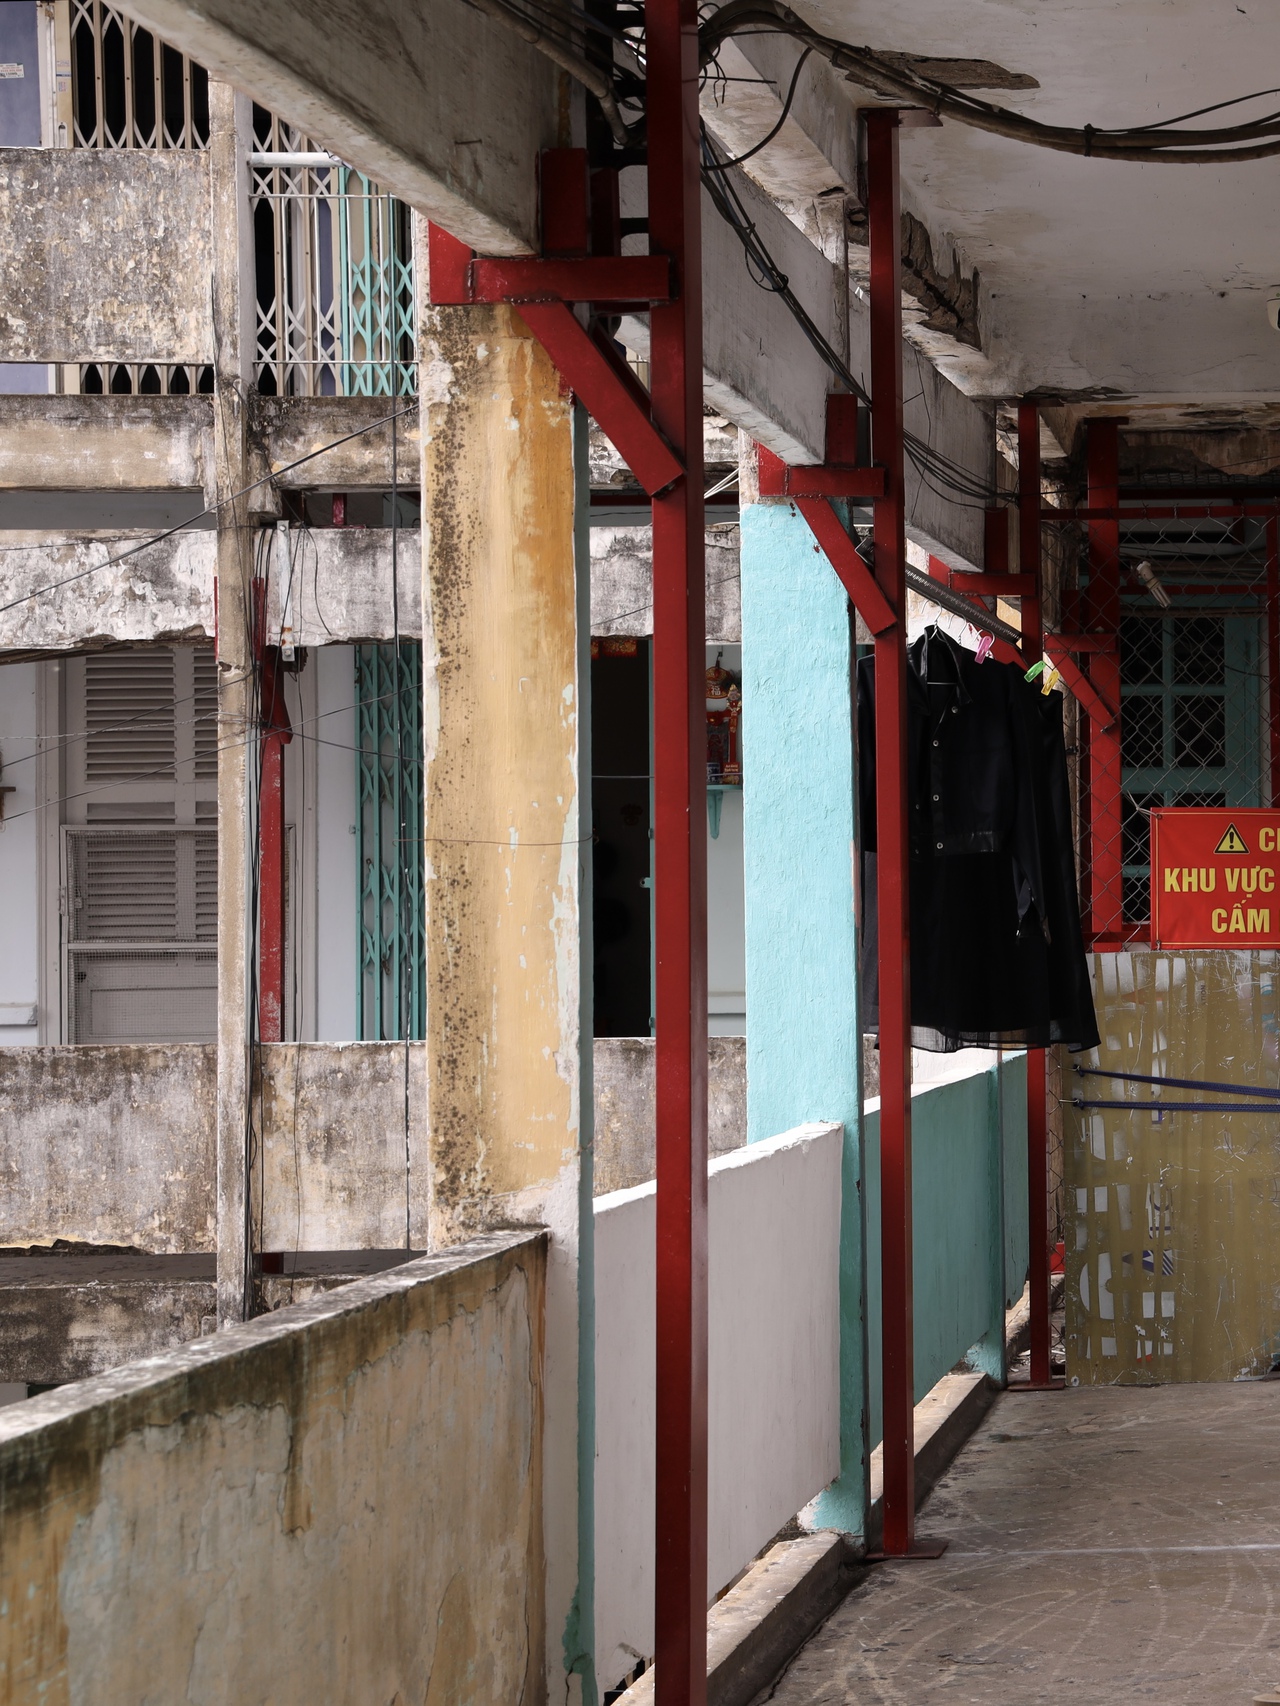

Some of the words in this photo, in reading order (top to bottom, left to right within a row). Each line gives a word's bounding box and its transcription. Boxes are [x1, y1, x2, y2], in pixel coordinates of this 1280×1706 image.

[1164, 868, 1216, 893] KHU
[1224, 865, 1275, 898] VỰC
[1211, 899, 1270, 934] CẤM
